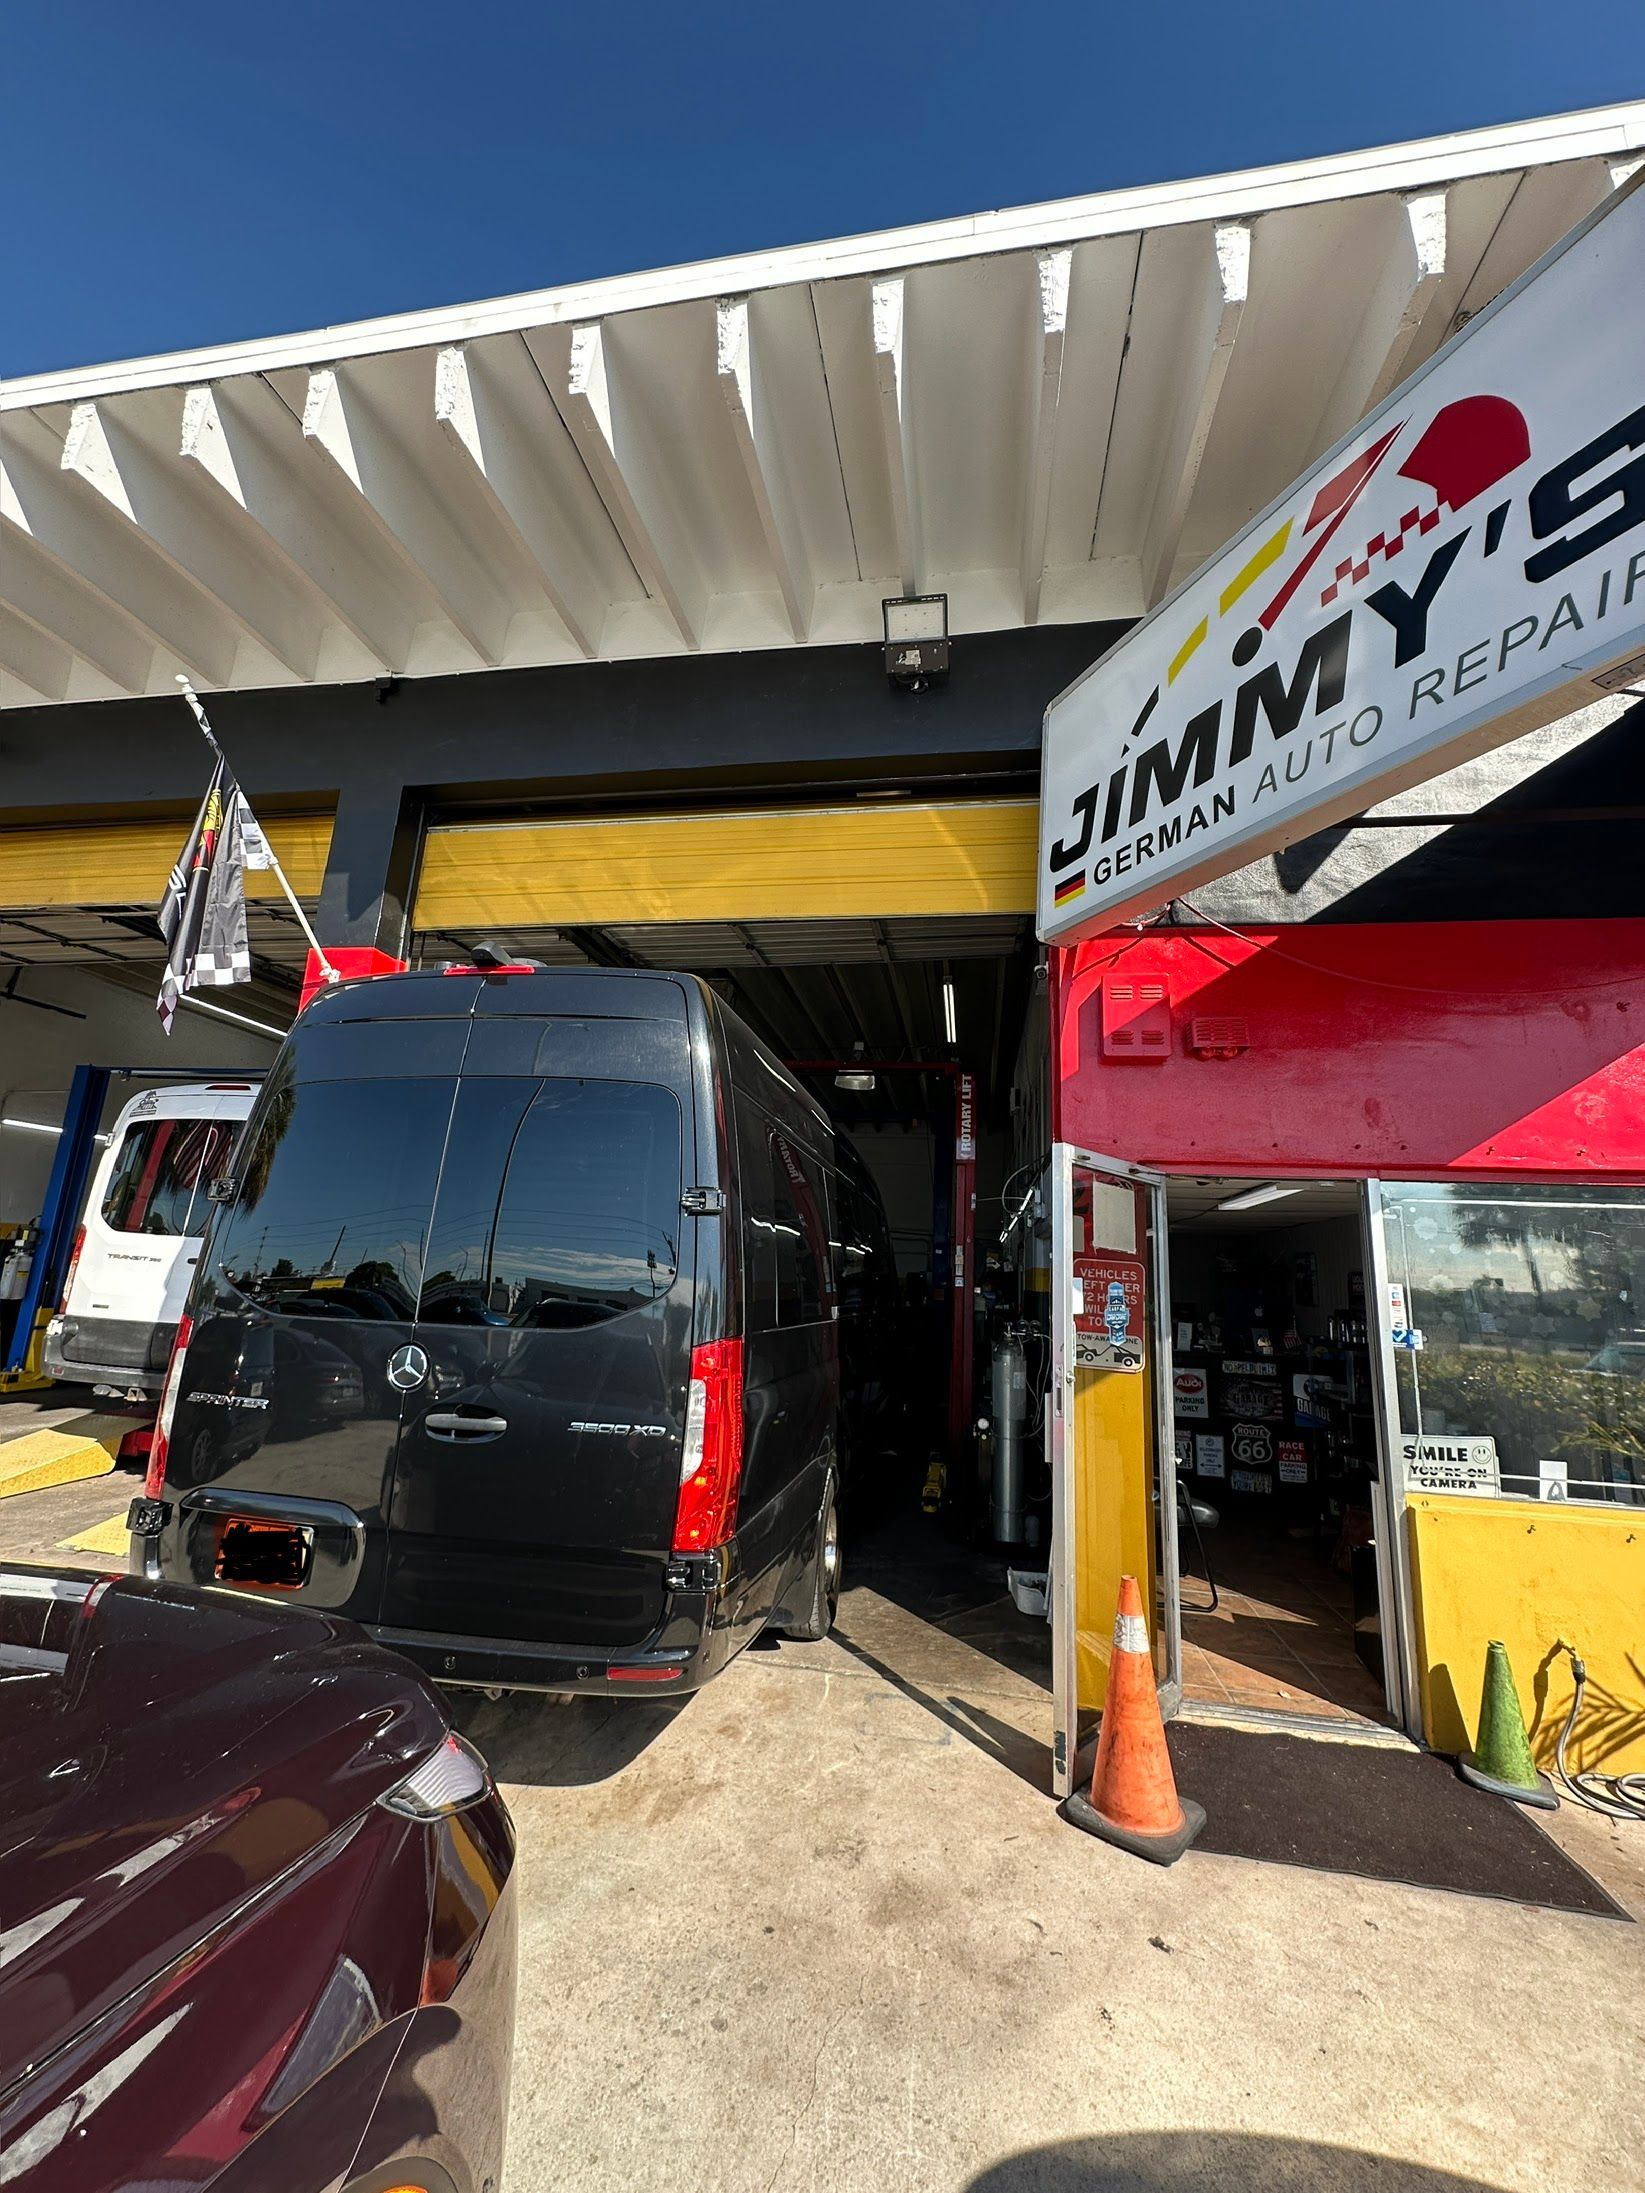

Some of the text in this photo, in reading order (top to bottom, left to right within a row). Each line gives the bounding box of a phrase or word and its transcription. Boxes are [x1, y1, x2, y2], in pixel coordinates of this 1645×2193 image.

[1094, 785, 1235, 885] GERMAN
[1252, 705, 1384, 804] AUTO
[961, 1074, 972, 1151] ROTARY LIFT
[107, 1253, 149, 1261] TRANSIT
[1080, 1268, 1137, 1280] VEHICLES
[1084, 1280, 1105, 1290] EFT
[1098, 1293, 1138, 1305] HRS
[1085, 1304, 1104, 1313] WIL
[1077, 1333, 1111, 1342] TOW-AWA
[1175, 1397, 1205, 1405] PARKING
[1182, 1404, 1199, 1412] ONLY
[1238, 1427, 1264, 1435] ROUTE
[1238, 1440, 1265, 1459] 66
[1279, 1441, 1304, 1450] RACE
[1282, 1453, 1302, 1461] CAR
[1403, 1445, 1468, 1461] SMILE
[1410, 1465, 1487, 1477] YOU'RE ON
[1420, 1478, 1477, 1489] CAMERA
